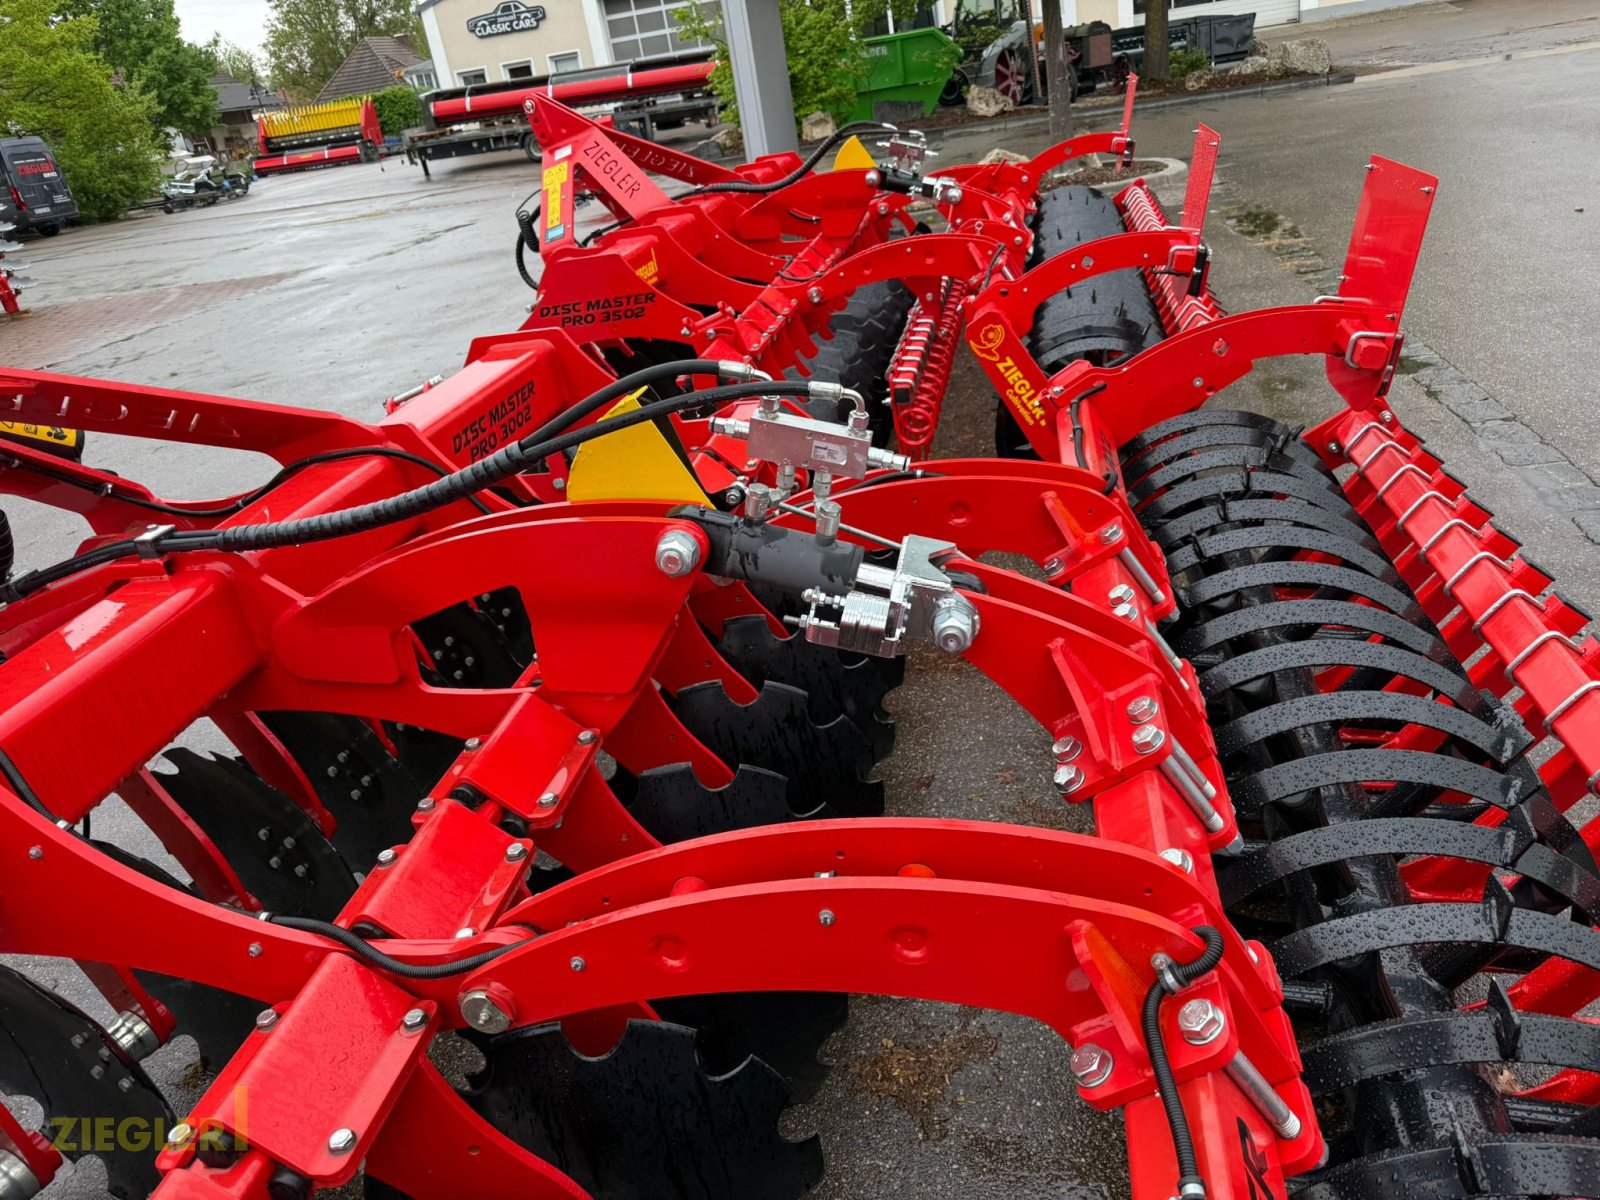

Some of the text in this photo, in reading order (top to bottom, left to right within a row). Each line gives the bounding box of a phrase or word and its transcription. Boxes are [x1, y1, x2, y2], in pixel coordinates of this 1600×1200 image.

[475, 18, 537, 36] CLASSIC CARS
[16, 162, 54, 177] ZIEGLER
[583, 141, 641, 199] ZIEGLER
[540, 292, 656, 318] DISC MASTER
[561, 306, 646, 328] PRO 3502
[452, 380, 536, 455] DISC MASTER
[1005, 388, 1035, 427] Cultivation
[470, 404, 532, 464] PRO 3002
